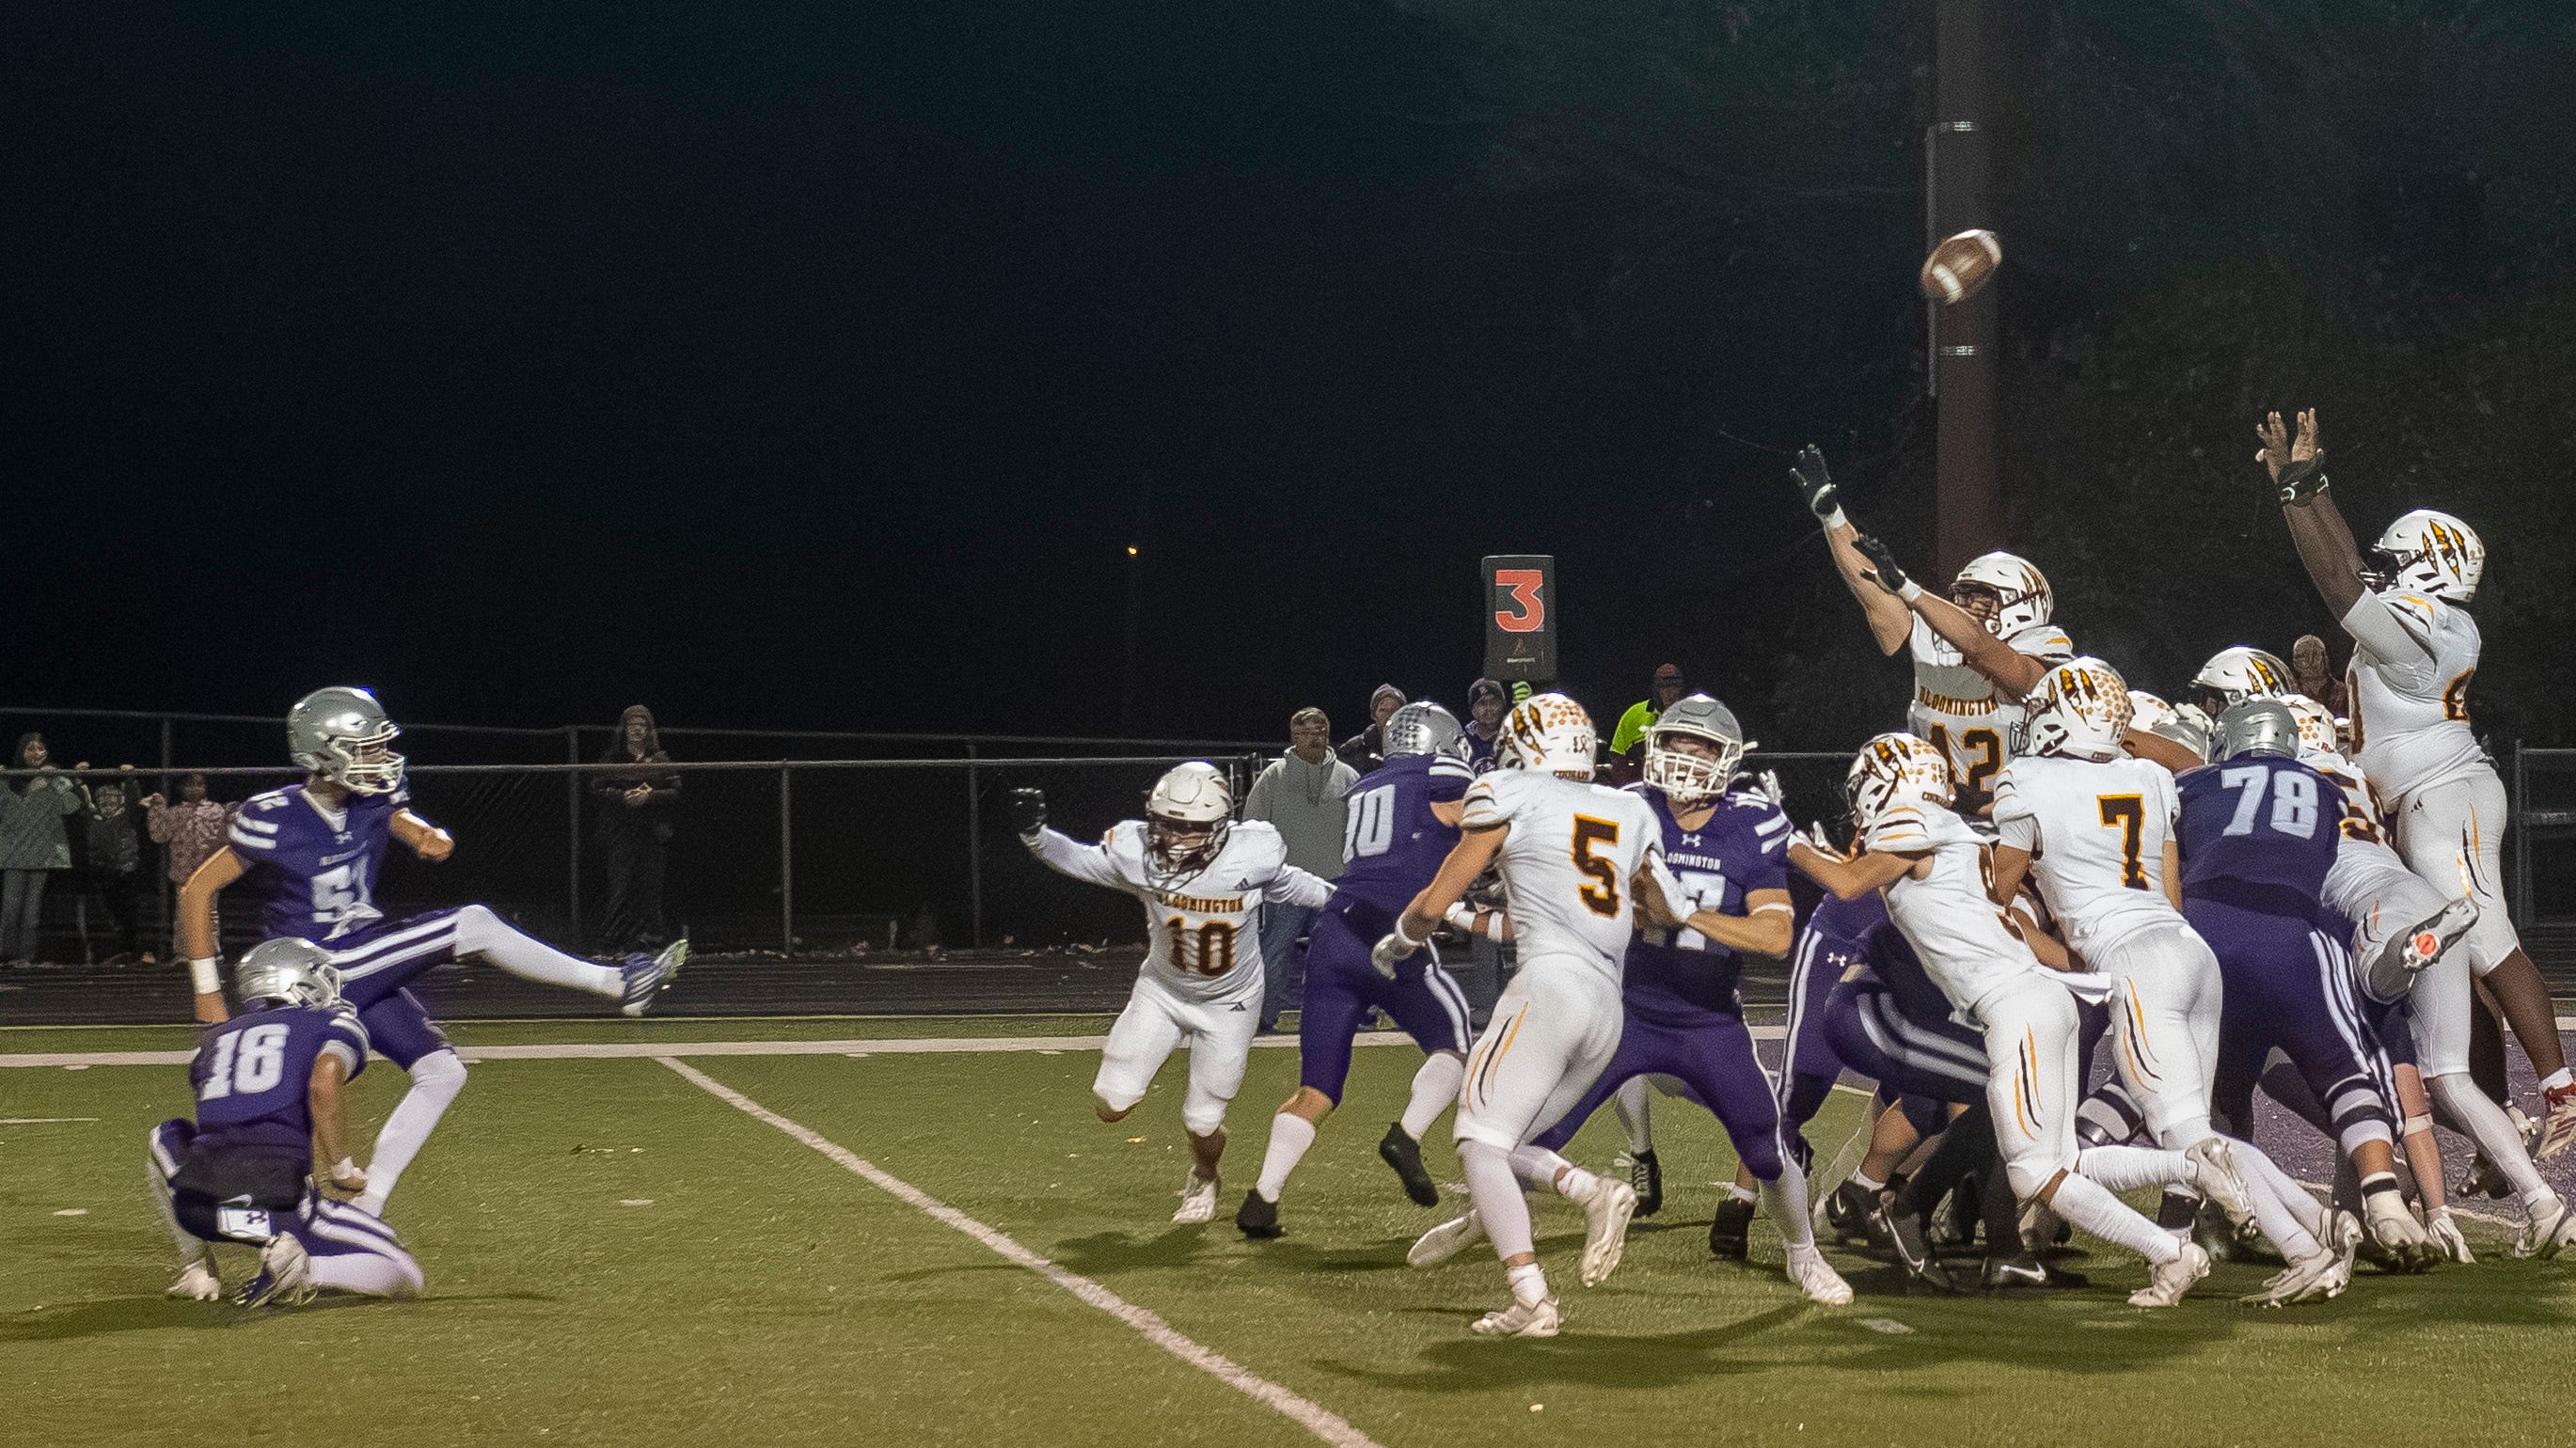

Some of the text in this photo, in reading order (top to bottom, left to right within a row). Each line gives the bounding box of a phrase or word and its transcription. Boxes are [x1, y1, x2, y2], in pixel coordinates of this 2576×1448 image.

[1494, 569, 1544, 632] 3
[1342, 783, 1396, 865] 10
[2220, 765, 2318, 841] 78
[1572, 812, 1620, 920] 5
[2096, 794, 2151, 891] 7
[1166, 915, 1235, 978] 10
[200, 1023, 291, 1101] 18
